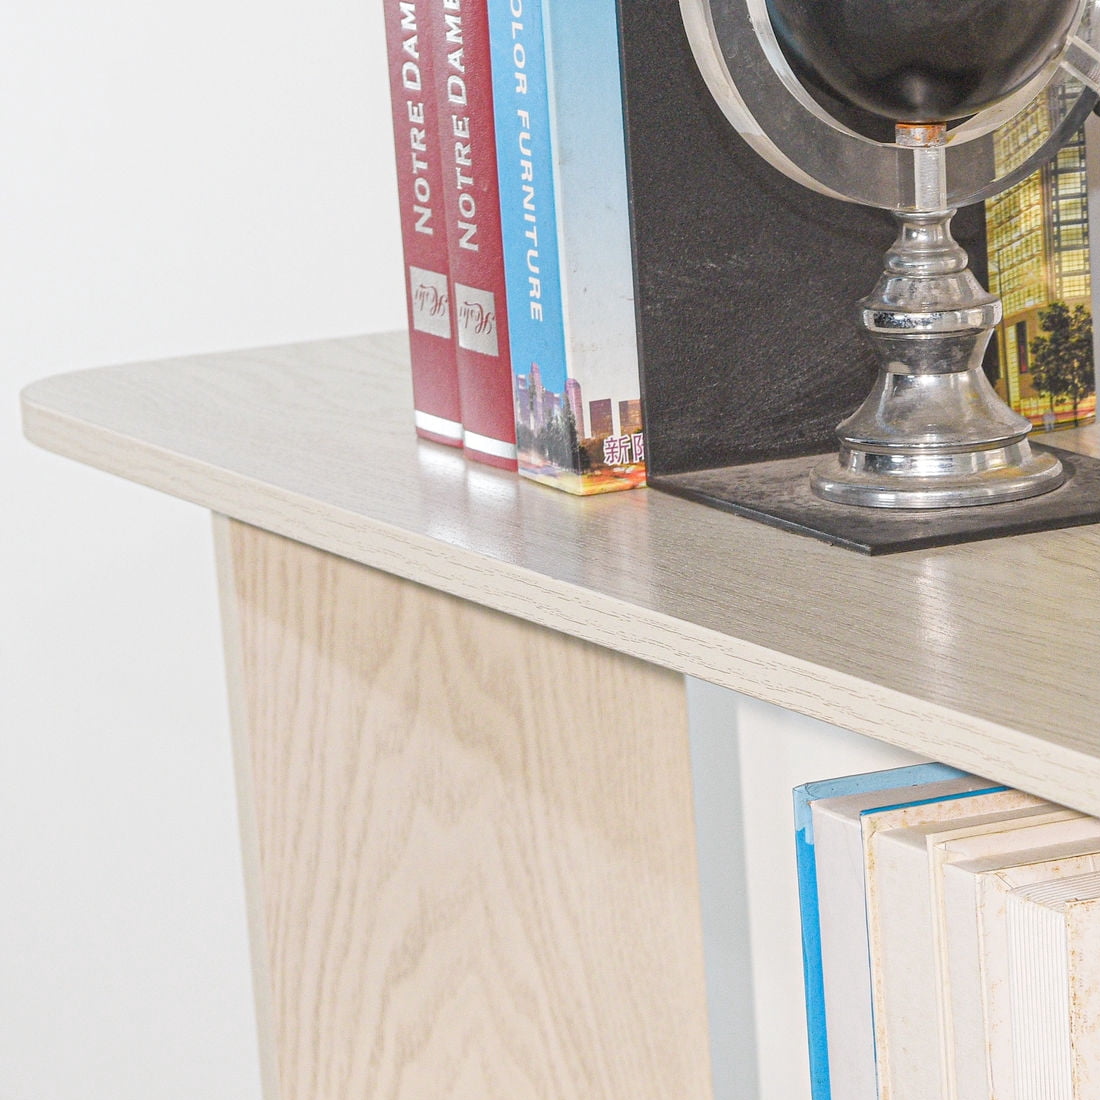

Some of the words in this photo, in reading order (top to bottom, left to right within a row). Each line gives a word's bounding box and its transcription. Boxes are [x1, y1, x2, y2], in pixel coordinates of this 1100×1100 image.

[400, 3, 421, 91] DAM
[443, 0, 468, 105] DAME
[407, 101, 433, 235] NOTRE
[451, 115, 479, 251] NOTRE
[516, 109, 544, 322] FURNITURE
